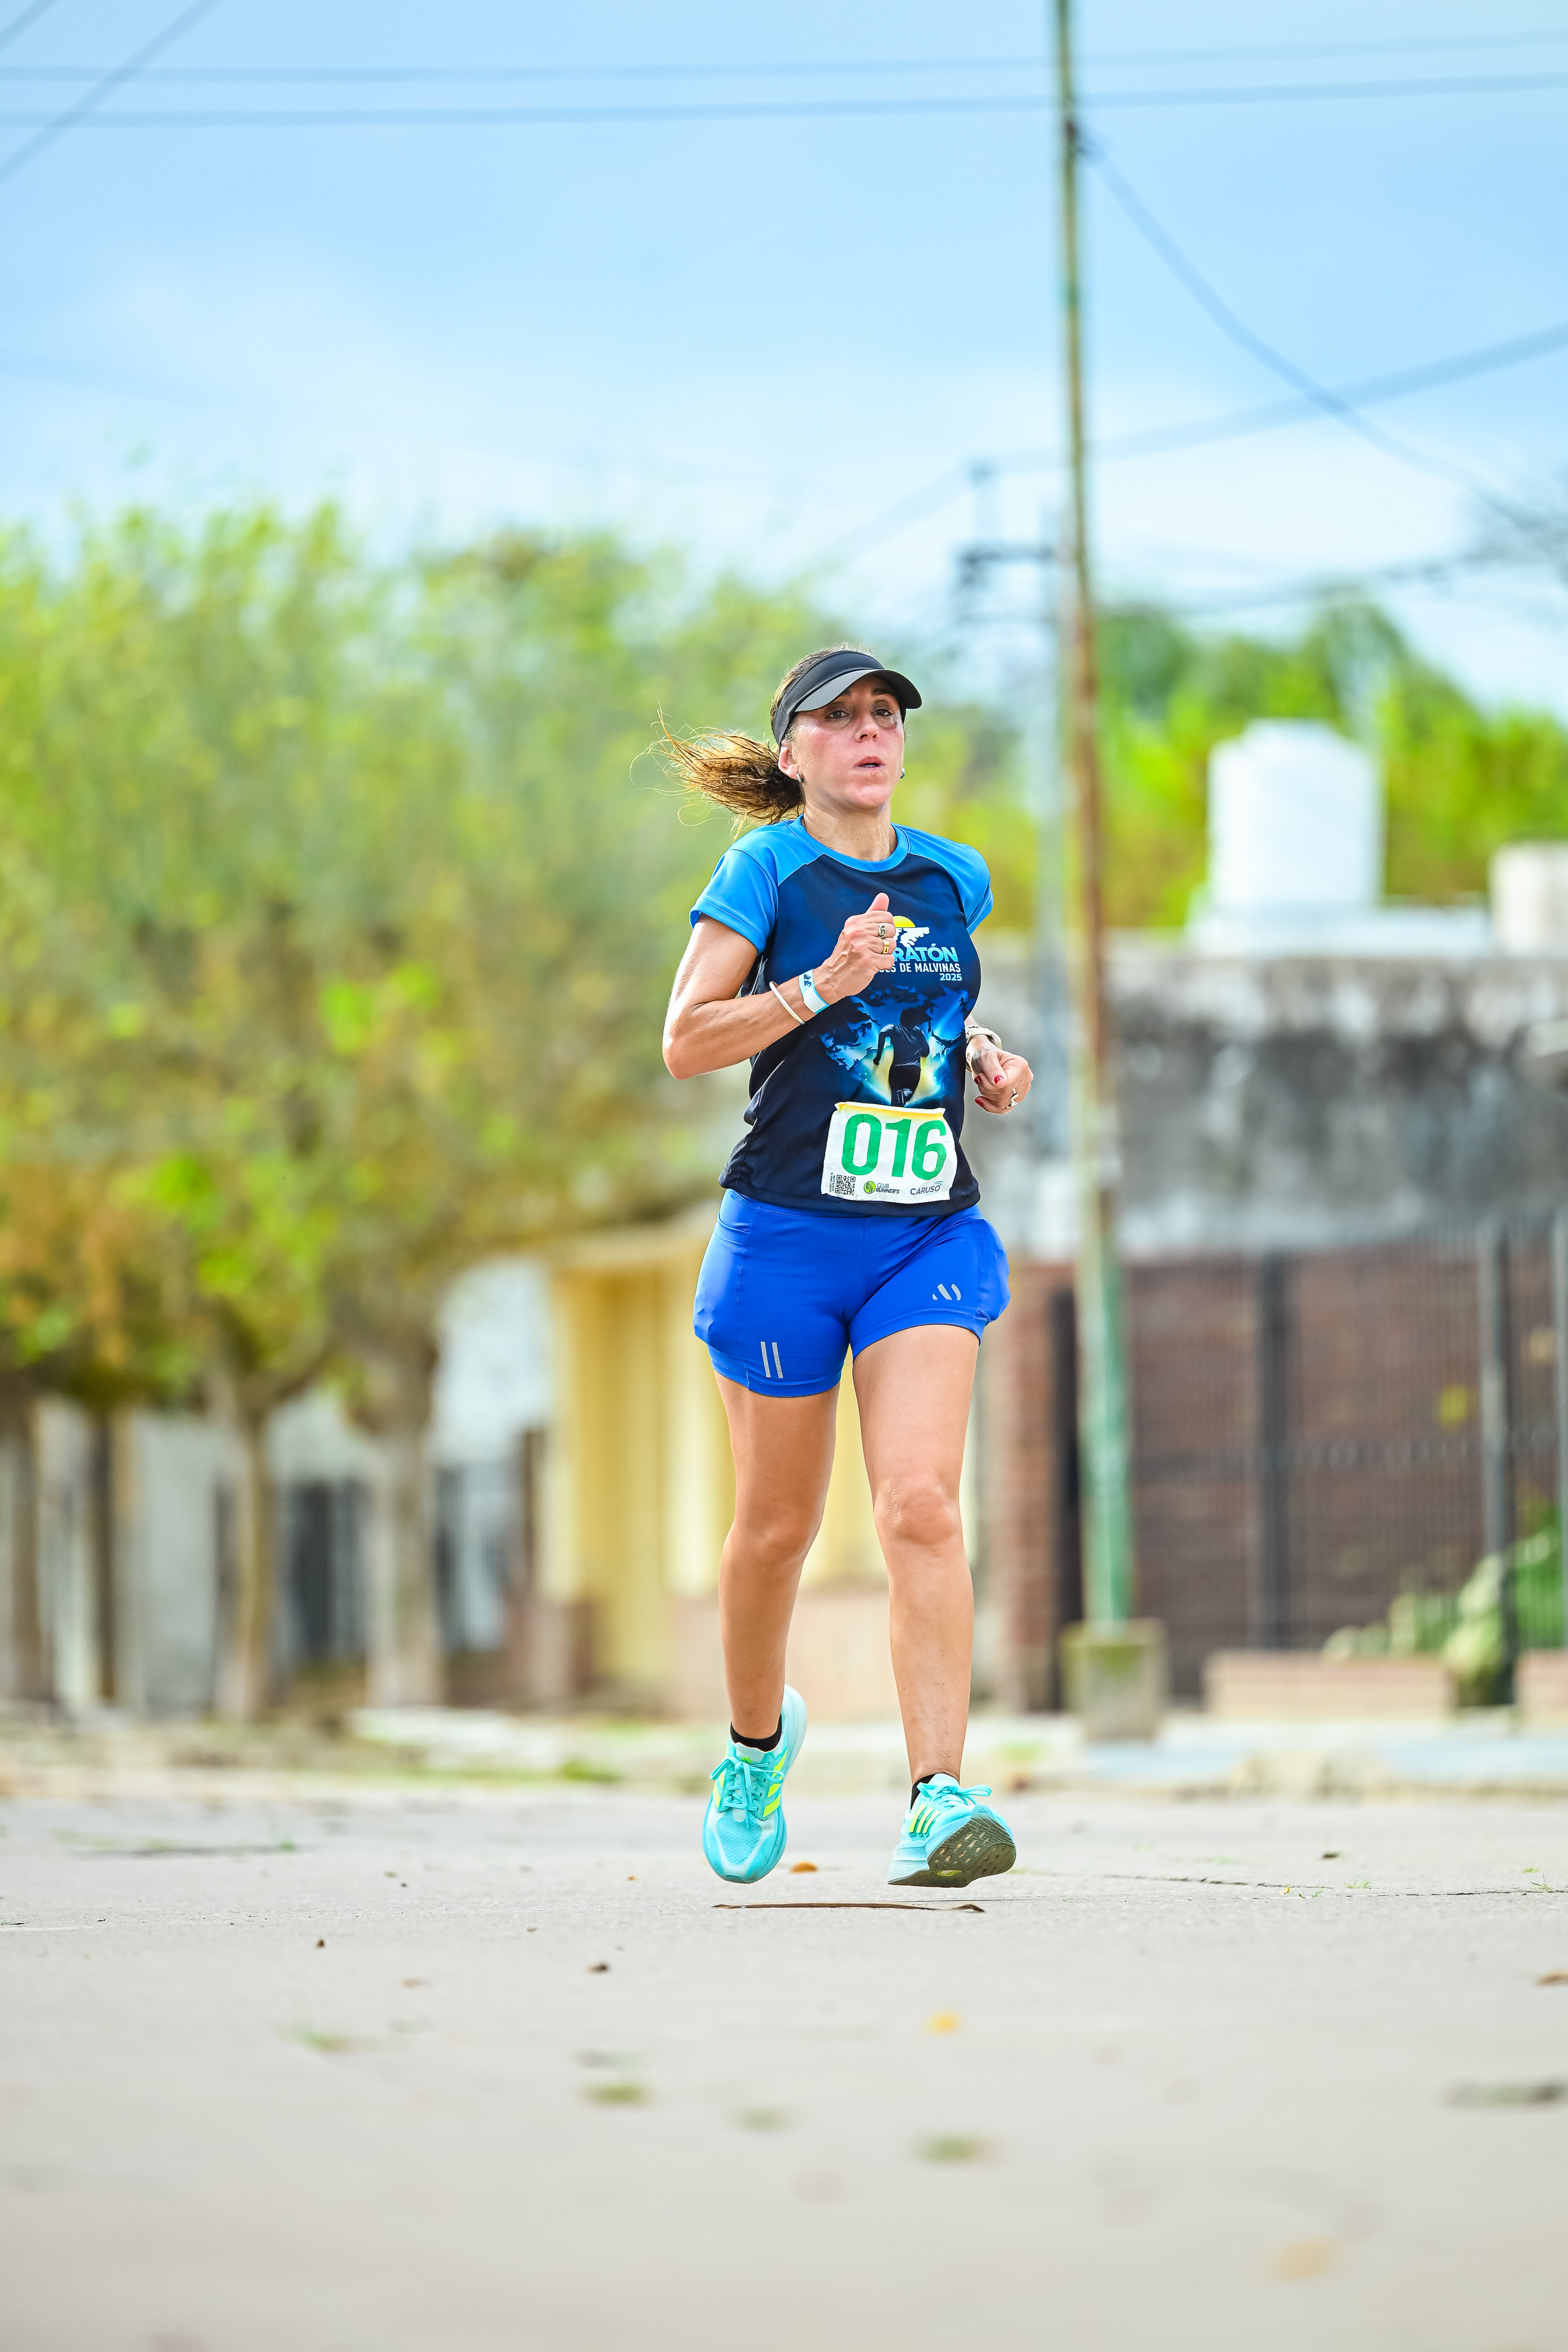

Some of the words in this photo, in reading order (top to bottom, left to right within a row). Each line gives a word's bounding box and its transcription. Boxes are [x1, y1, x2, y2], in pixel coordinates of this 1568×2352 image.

[892, 943, 959, 962] RATÓN
[900, 963, 912, 972] DE
[915, 963, 961, 973] MALVINAS
[842, 1114, 947, 1180] 016
[910, 1185, 940, 1195] CARUSO
